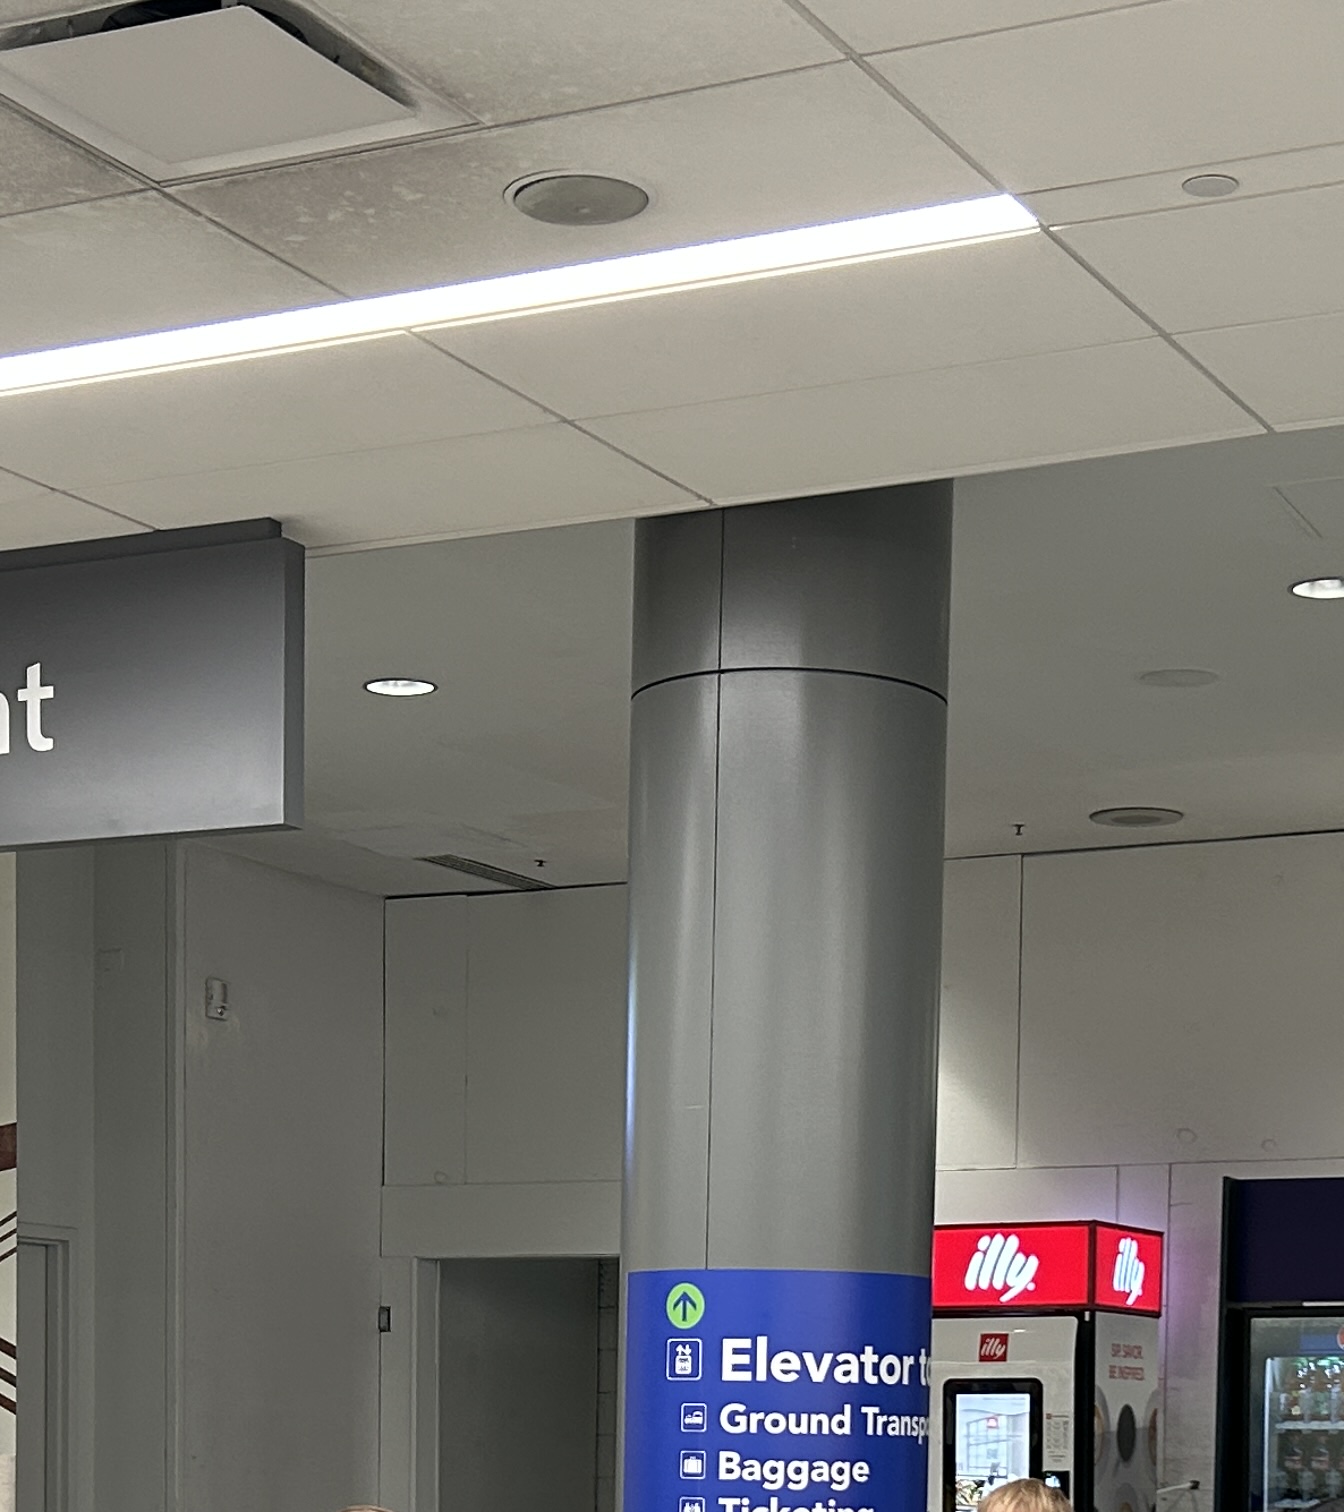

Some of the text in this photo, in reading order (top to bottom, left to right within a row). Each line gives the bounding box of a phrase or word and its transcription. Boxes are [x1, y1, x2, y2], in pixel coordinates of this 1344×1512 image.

[964, 1232, 1039, 1302] illy
[1112, 1237, 1145, 1305] illy
[720, 1335, 914, 1386] Elevator
[981, 1339, 1006, 1358] illy
[719, 1402, 929, 1444] Ground Transp
[718, 1450, 871, 1491] Baggage
